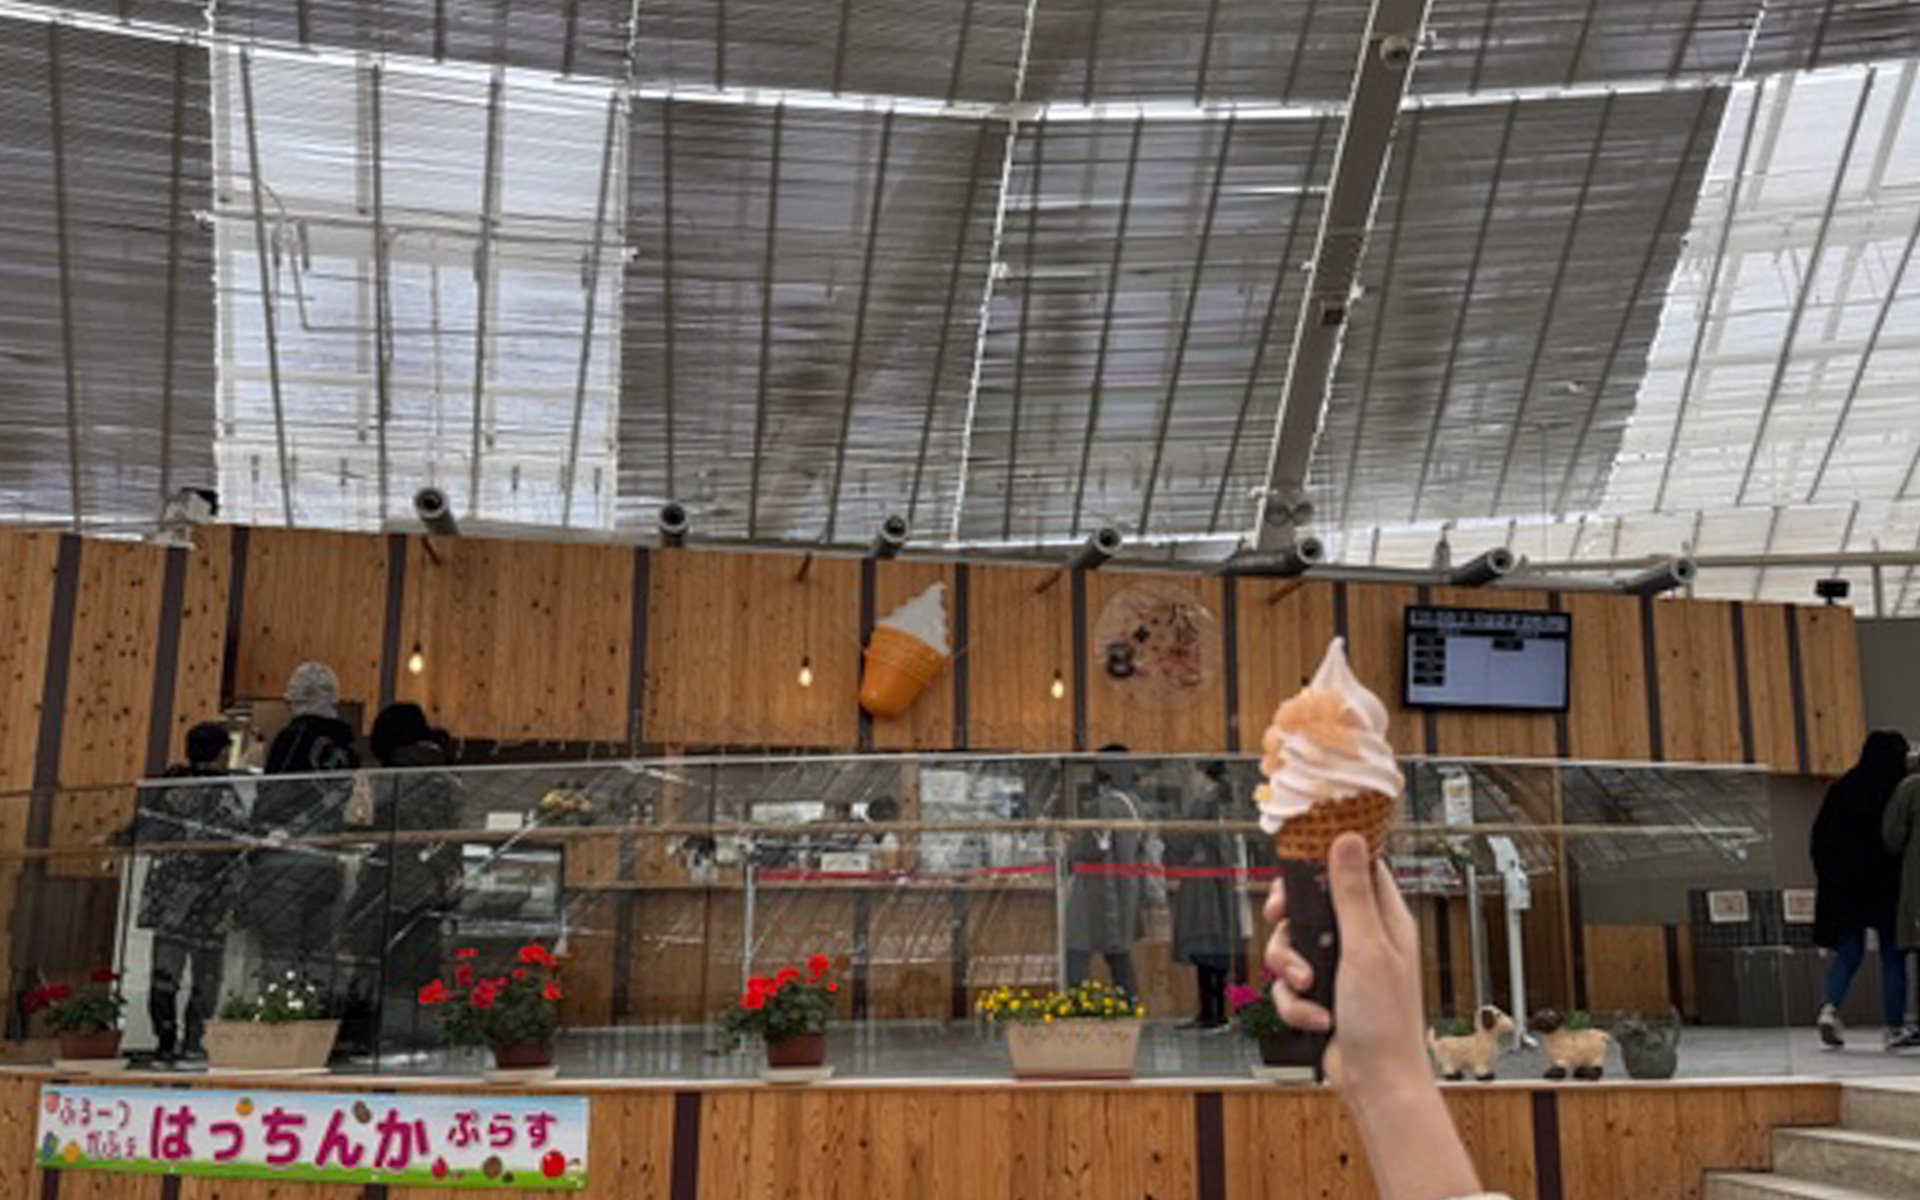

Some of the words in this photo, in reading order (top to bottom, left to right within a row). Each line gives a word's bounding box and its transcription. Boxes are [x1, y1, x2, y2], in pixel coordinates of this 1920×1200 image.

[149, 1104, 430, 1169] はっちんか
[447, 1109, 557, 1149] ぷらす
